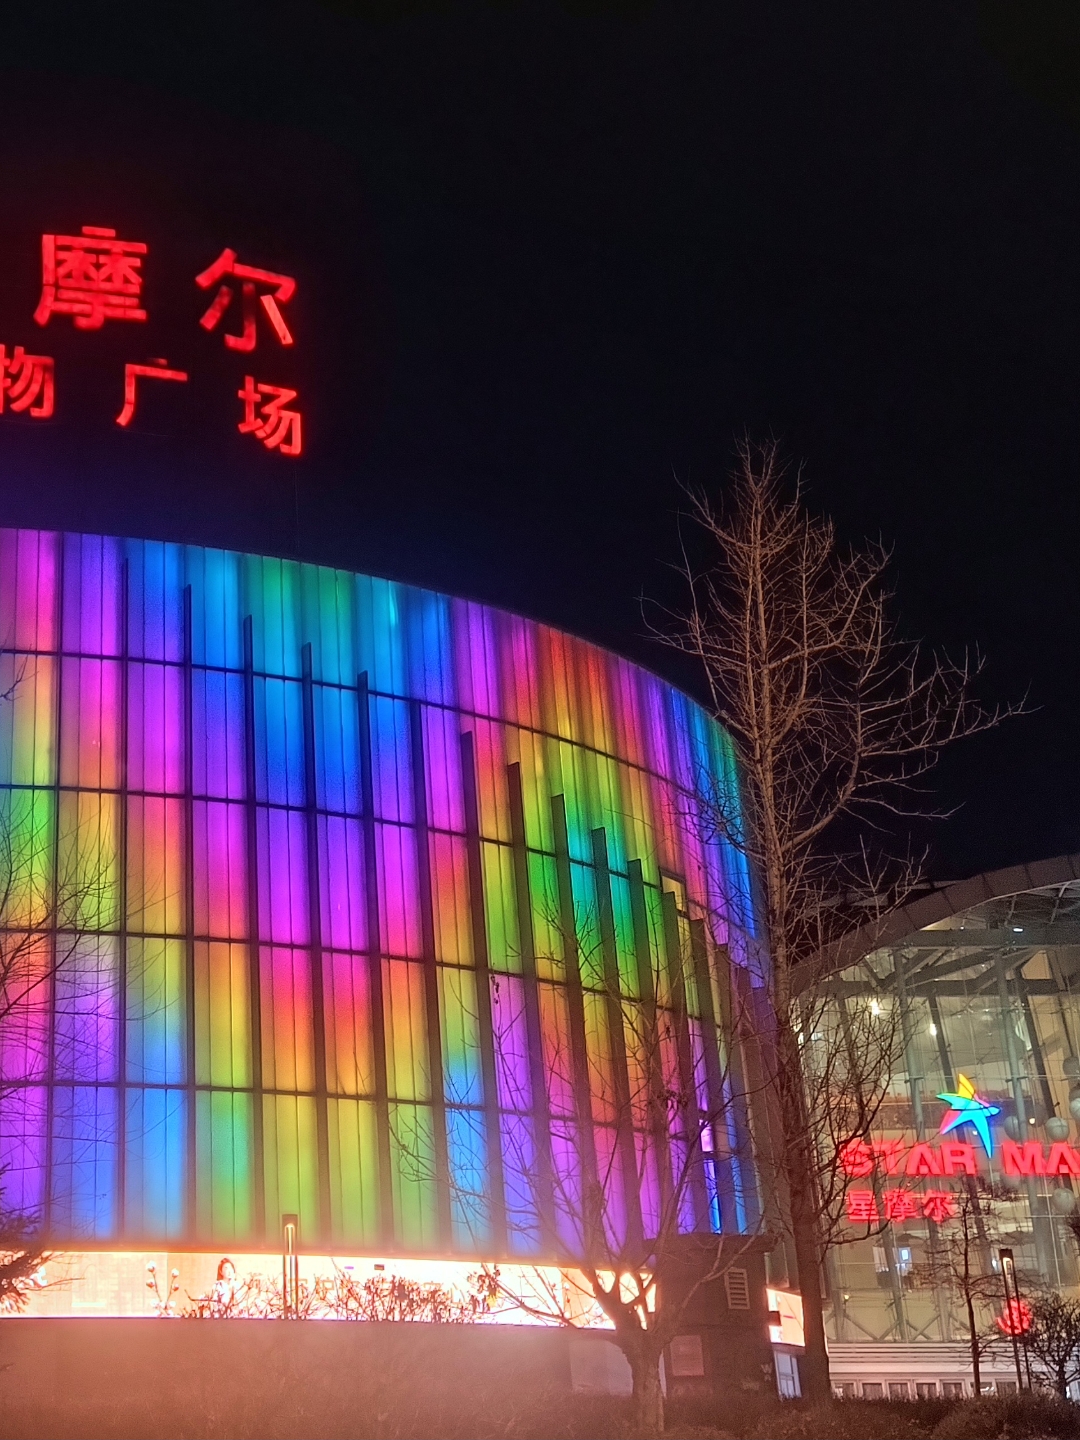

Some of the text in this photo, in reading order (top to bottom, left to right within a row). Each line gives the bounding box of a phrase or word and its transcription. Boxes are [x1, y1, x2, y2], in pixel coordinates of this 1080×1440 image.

[841, 1137, 977, 1178] STAR
[848, 1189, 958, 1223] 星摩尔
